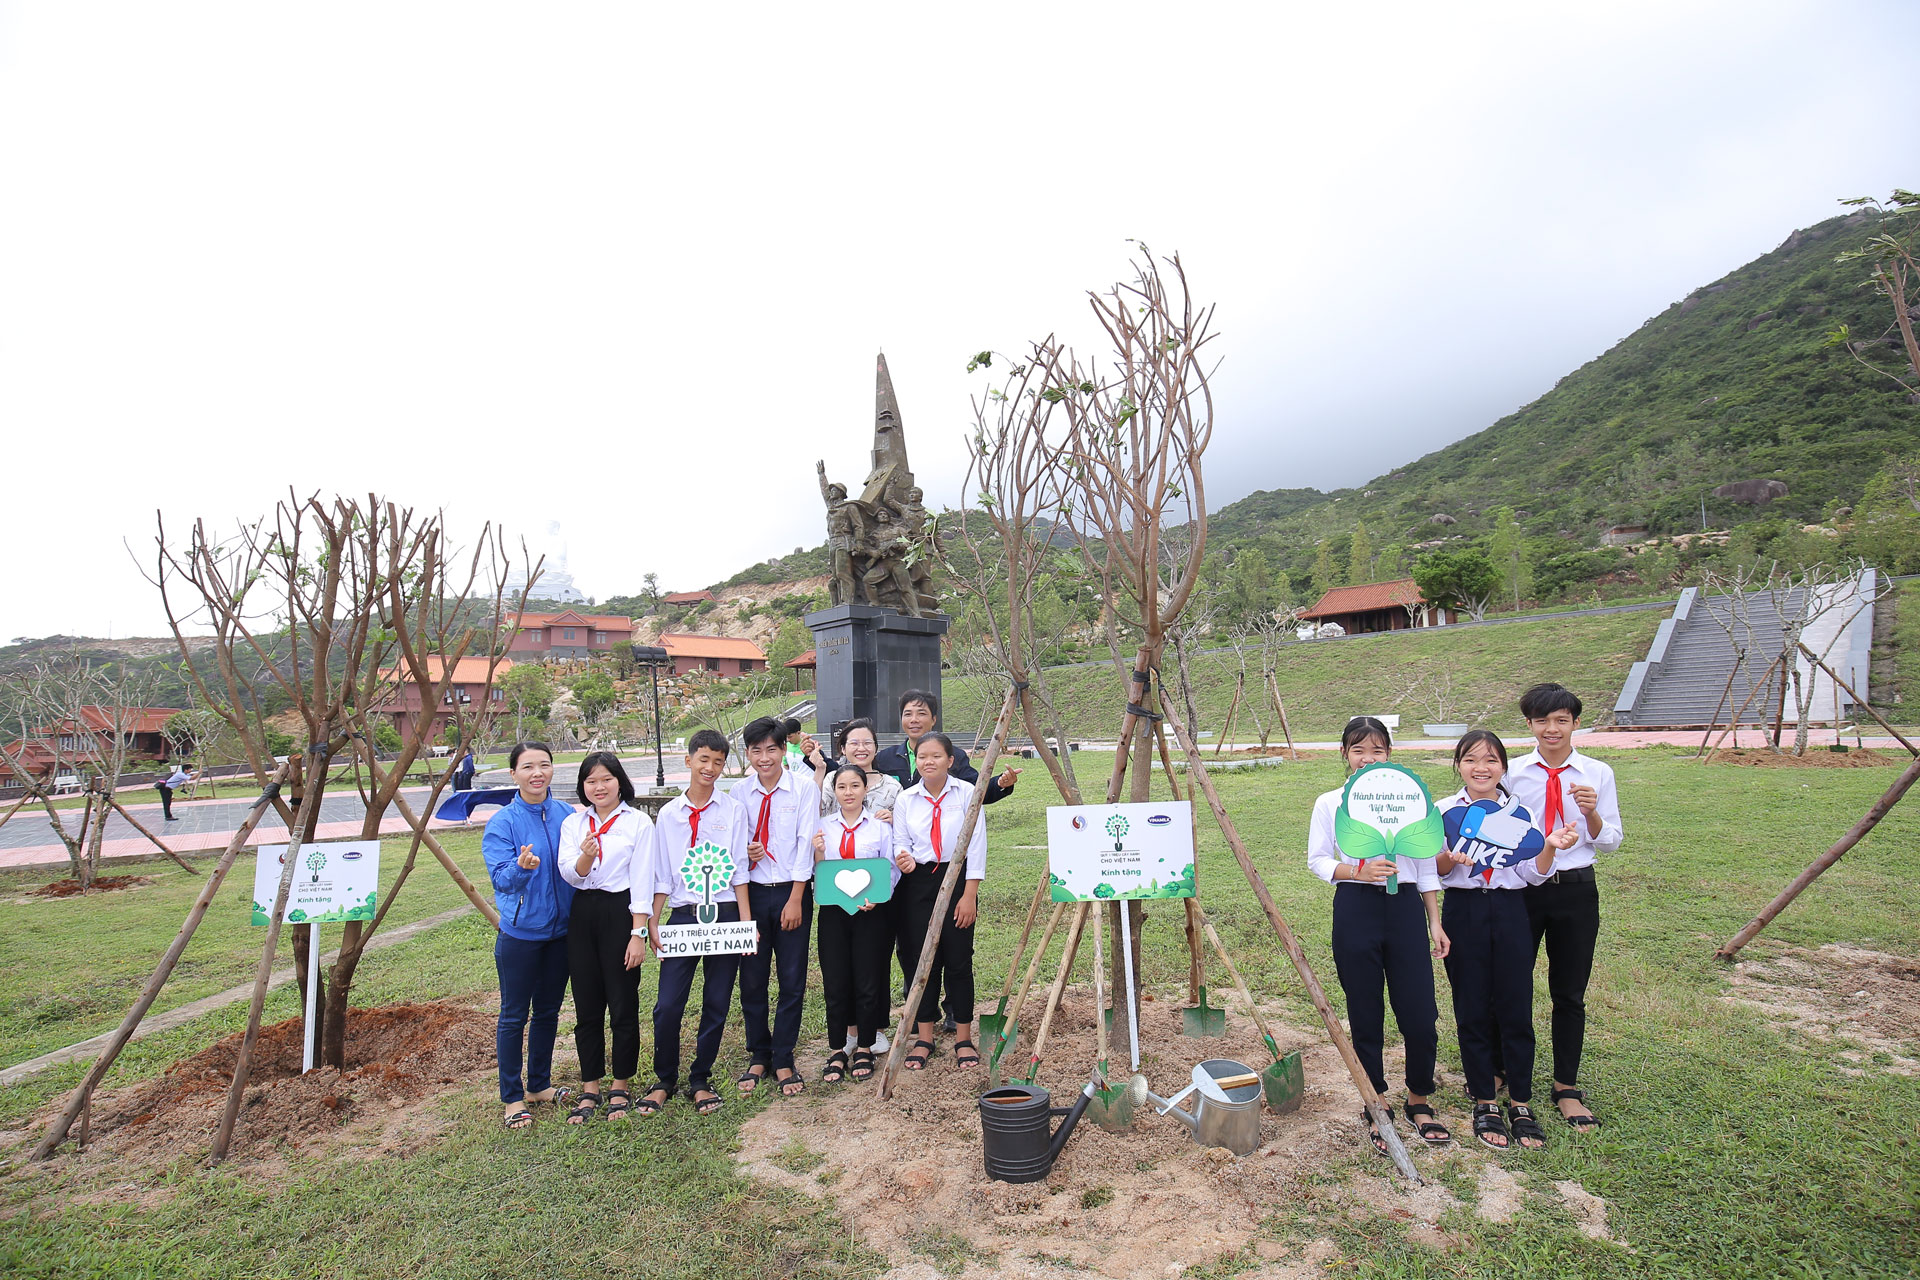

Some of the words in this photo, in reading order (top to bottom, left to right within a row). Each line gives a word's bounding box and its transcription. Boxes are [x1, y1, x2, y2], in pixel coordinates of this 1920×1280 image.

[1386, 804, 1405, 812] Nam
[1376, 816, 1398, 824] Xanh
[1452, 836, 1514, 870] LIKE
[687, 928, 708, 938] TRIỆU
[711, 927, 728, 936] CÂY
[660, 942, 687, 954] CHO
[692, 939, 719, 954] VIỆT
[724, 939, 754, 950] NAM
